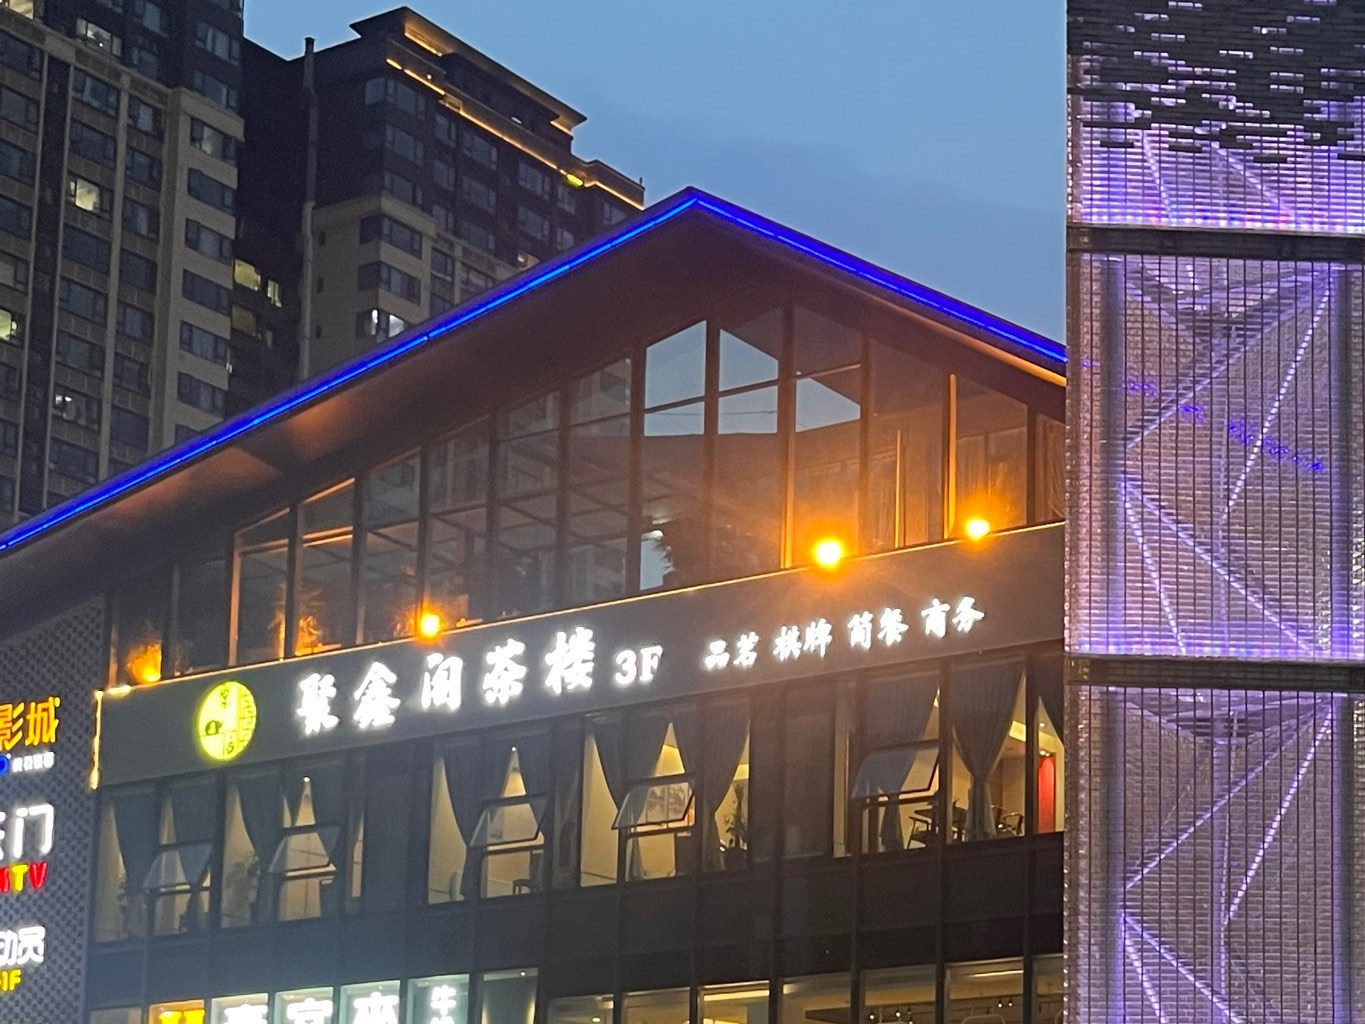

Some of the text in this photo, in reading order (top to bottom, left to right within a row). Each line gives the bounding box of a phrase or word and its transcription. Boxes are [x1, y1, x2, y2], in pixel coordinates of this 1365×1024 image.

[703, 596, 985, 670] 品茗 棋牌 简餐 商务
[614, 645, 664, 686] 3F
[0, 803, 55, 860] 门
[0, 968, 22, 992] 1F
